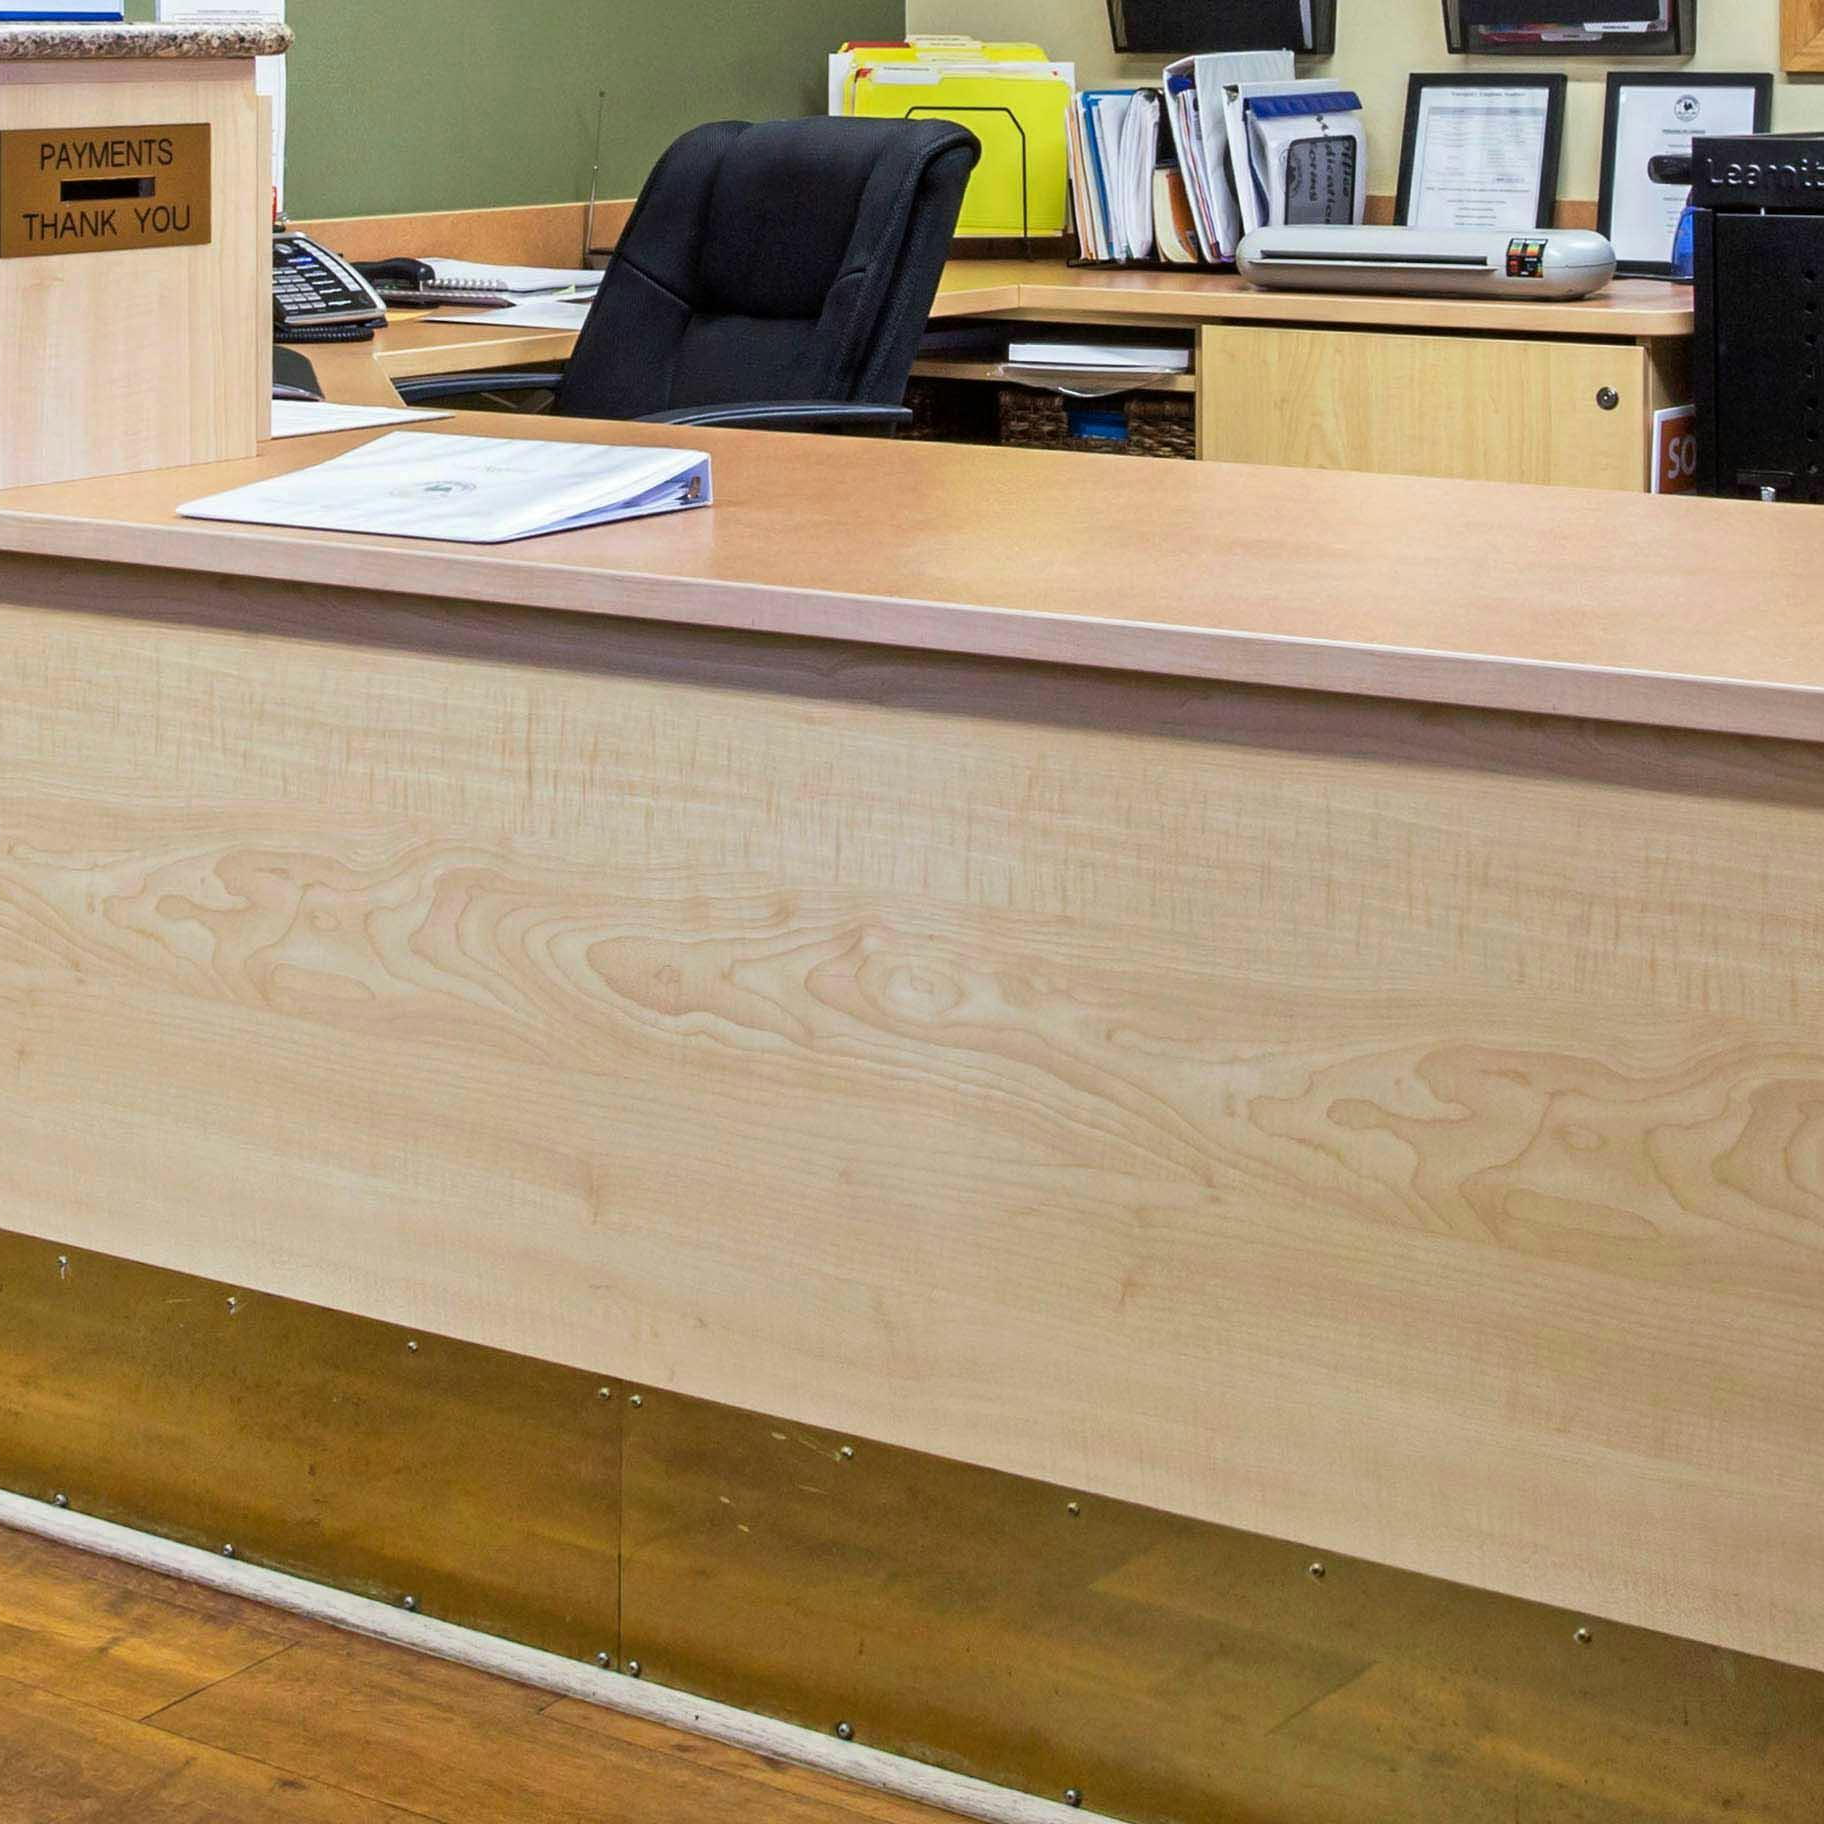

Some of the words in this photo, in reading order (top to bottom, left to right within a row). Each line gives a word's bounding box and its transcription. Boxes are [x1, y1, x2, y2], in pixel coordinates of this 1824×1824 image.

[39, 138, 173, 171] PAYMENTS
[22, 209, 118, 240] THANK
[134, 204, 191, 233] YOU
